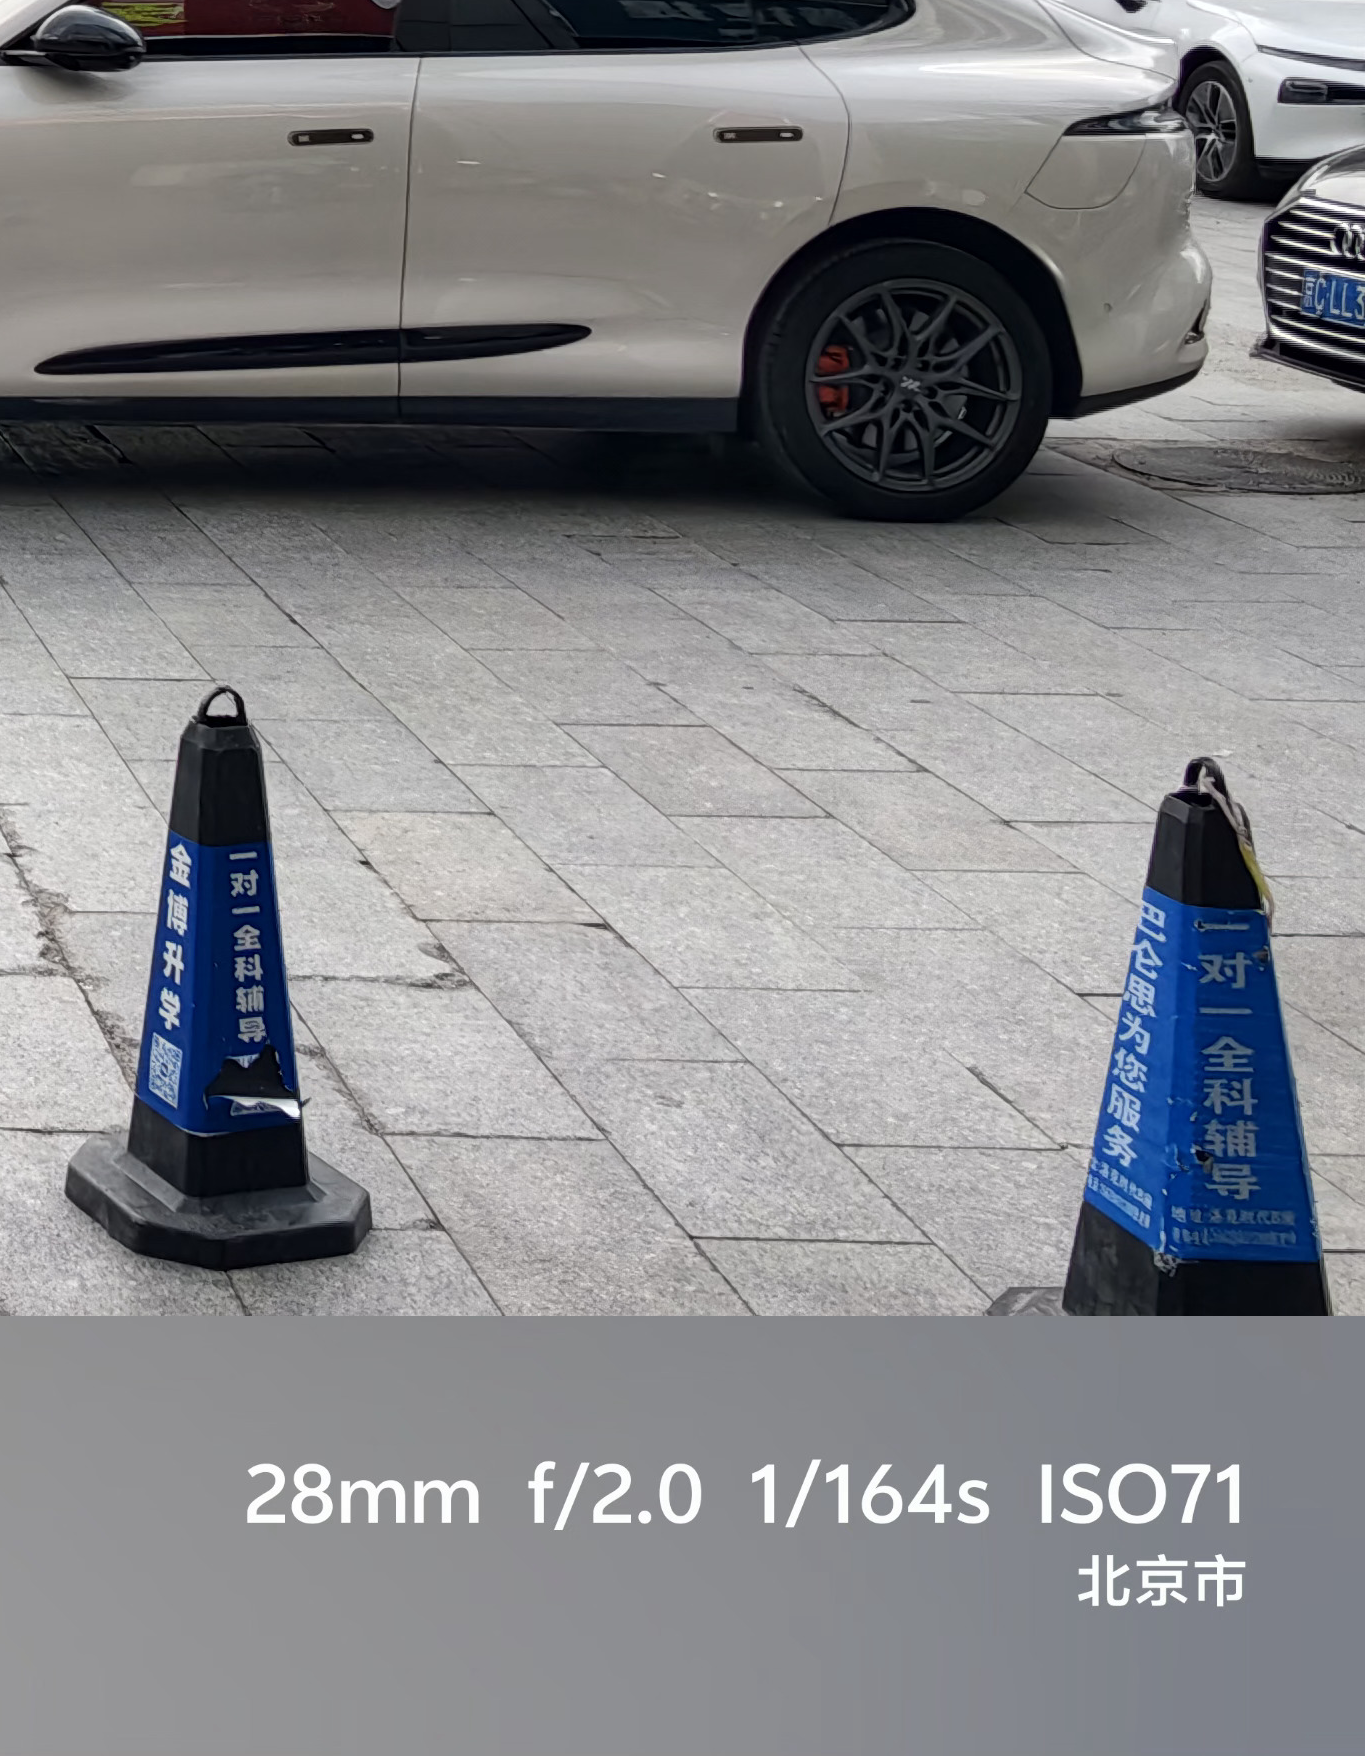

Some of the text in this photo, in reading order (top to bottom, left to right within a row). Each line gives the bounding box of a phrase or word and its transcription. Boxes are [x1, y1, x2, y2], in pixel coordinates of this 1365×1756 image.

[229, 850, 268, 1044] 一对一全科辅导
[1101, 899, 1167, 1169] 巴伦思为您服务
[1198, 921, 1262, 1202] 一对一全科辅导
